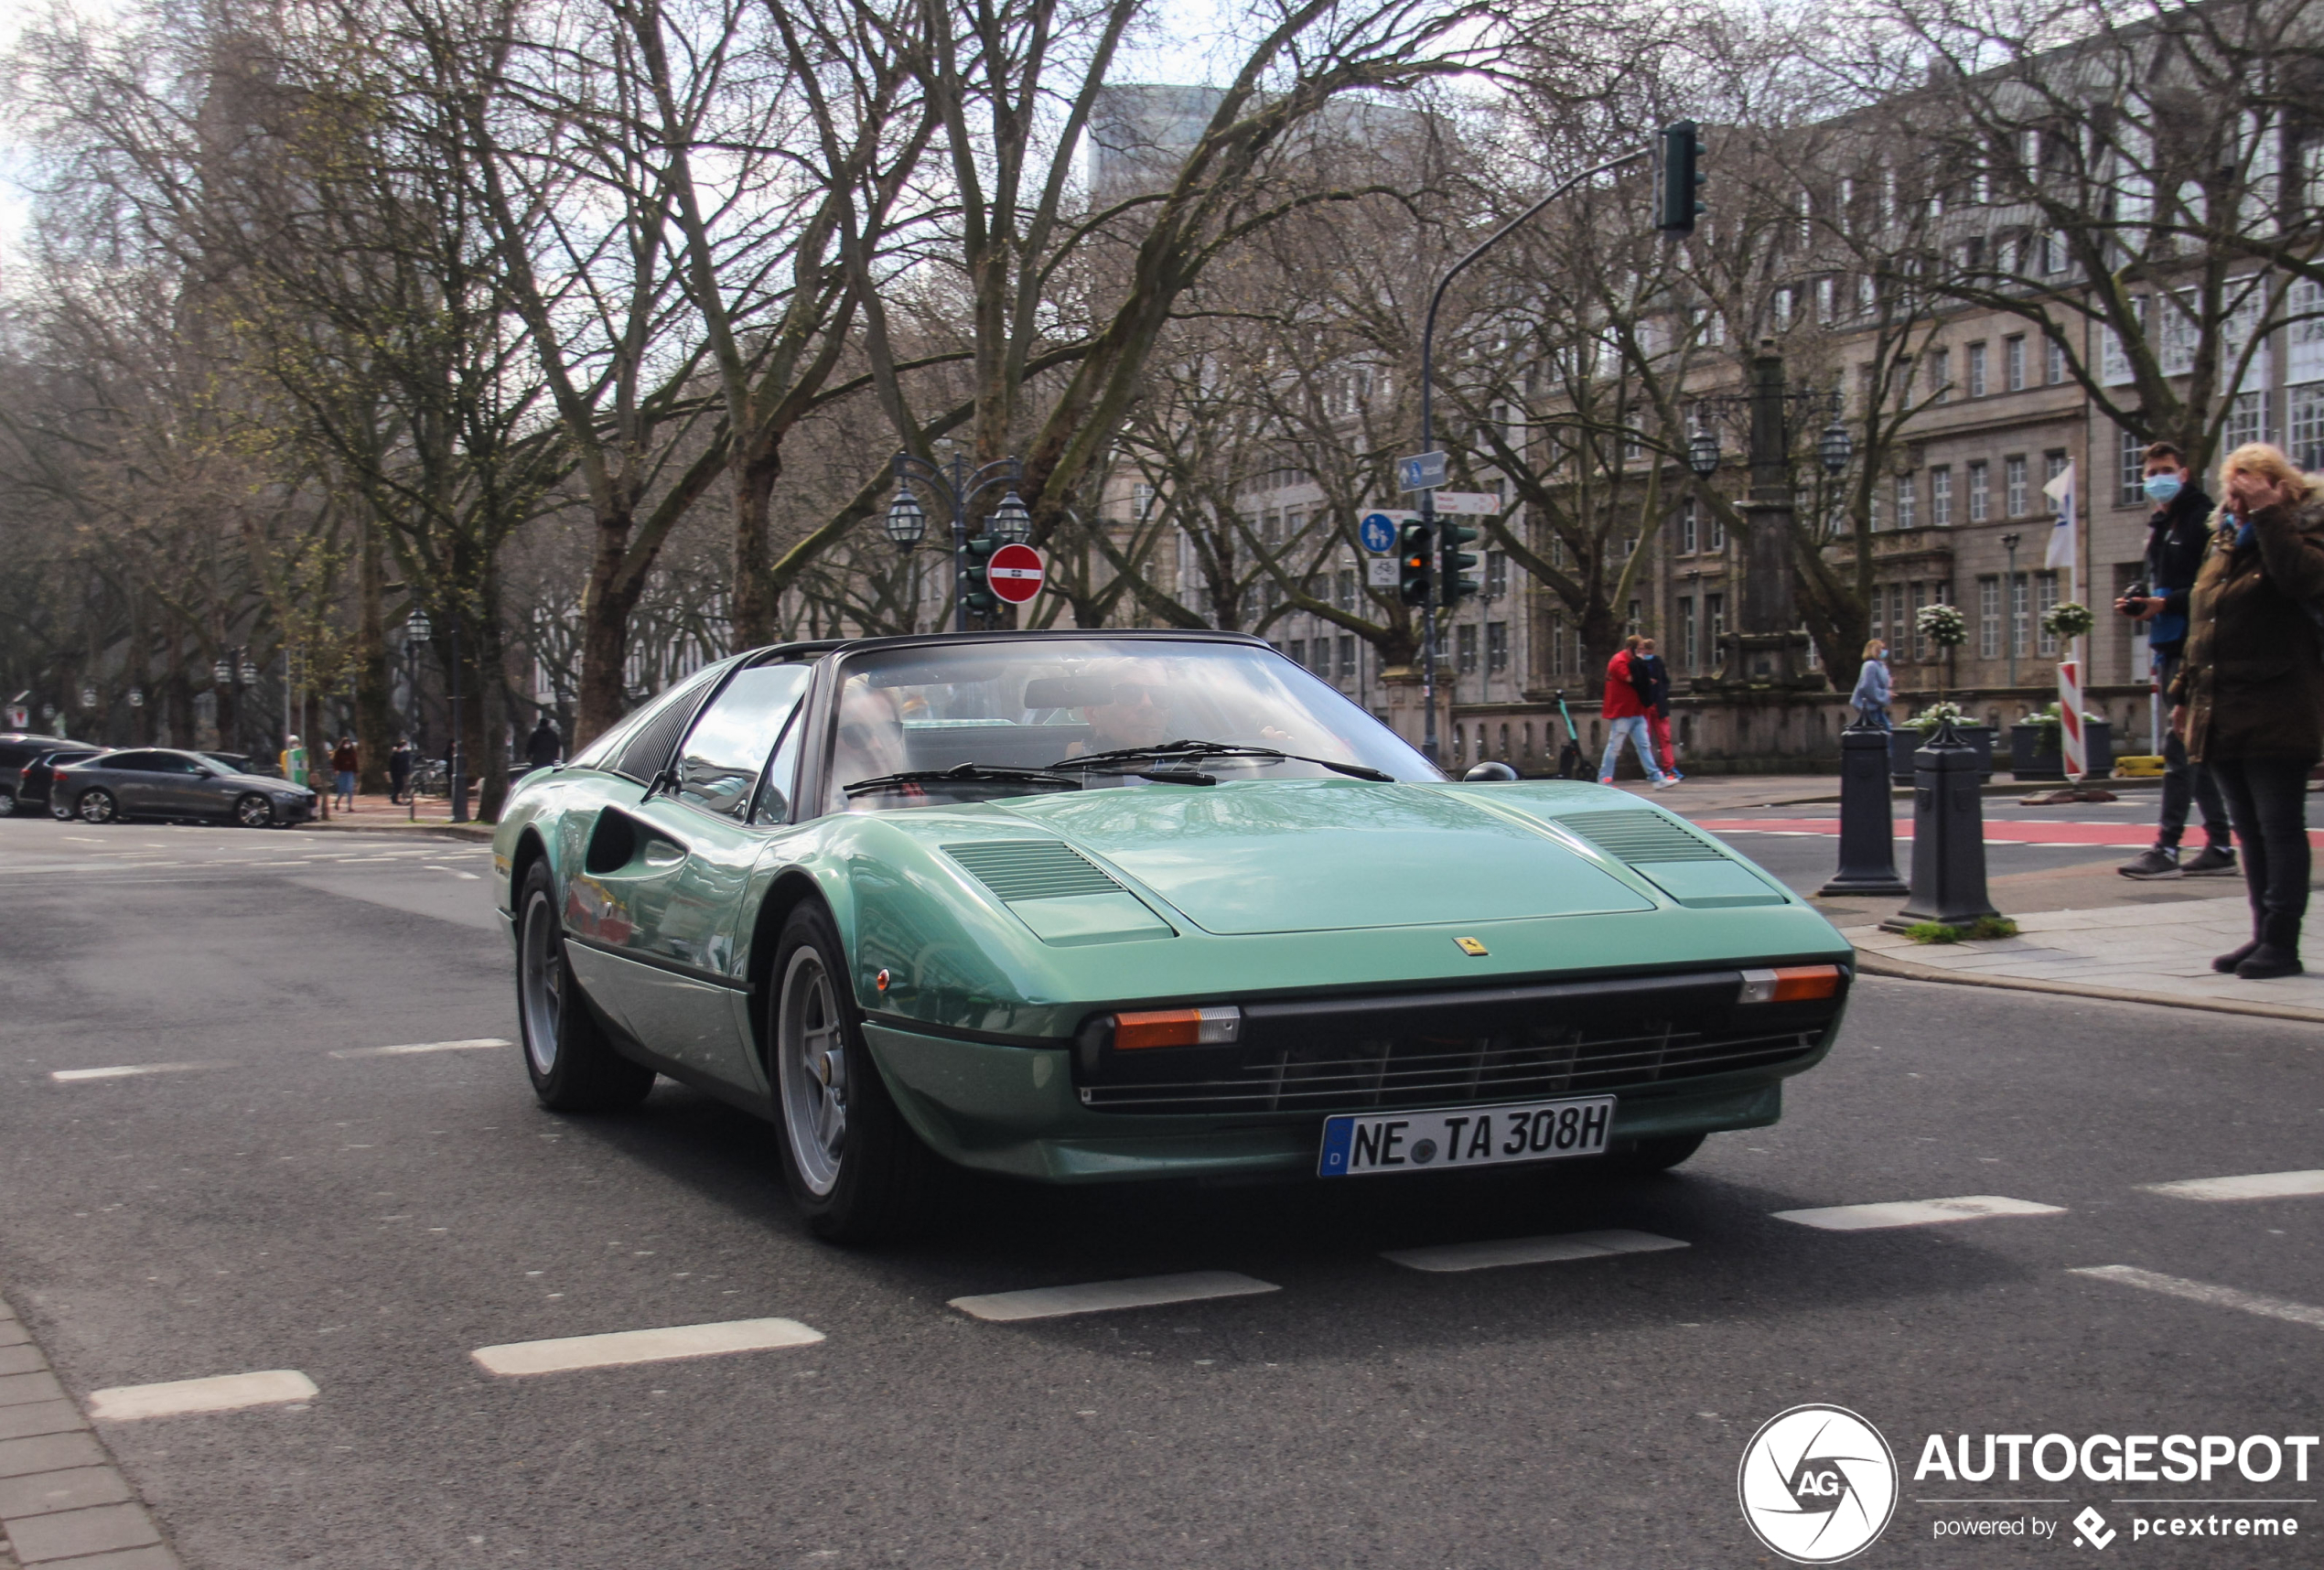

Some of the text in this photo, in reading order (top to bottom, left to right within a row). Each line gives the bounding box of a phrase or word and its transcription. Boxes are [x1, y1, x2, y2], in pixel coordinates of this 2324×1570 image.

[1351, 1103, 1609, 1167] NE TA 308H
[1329, 1153, 1341, 1166] D
